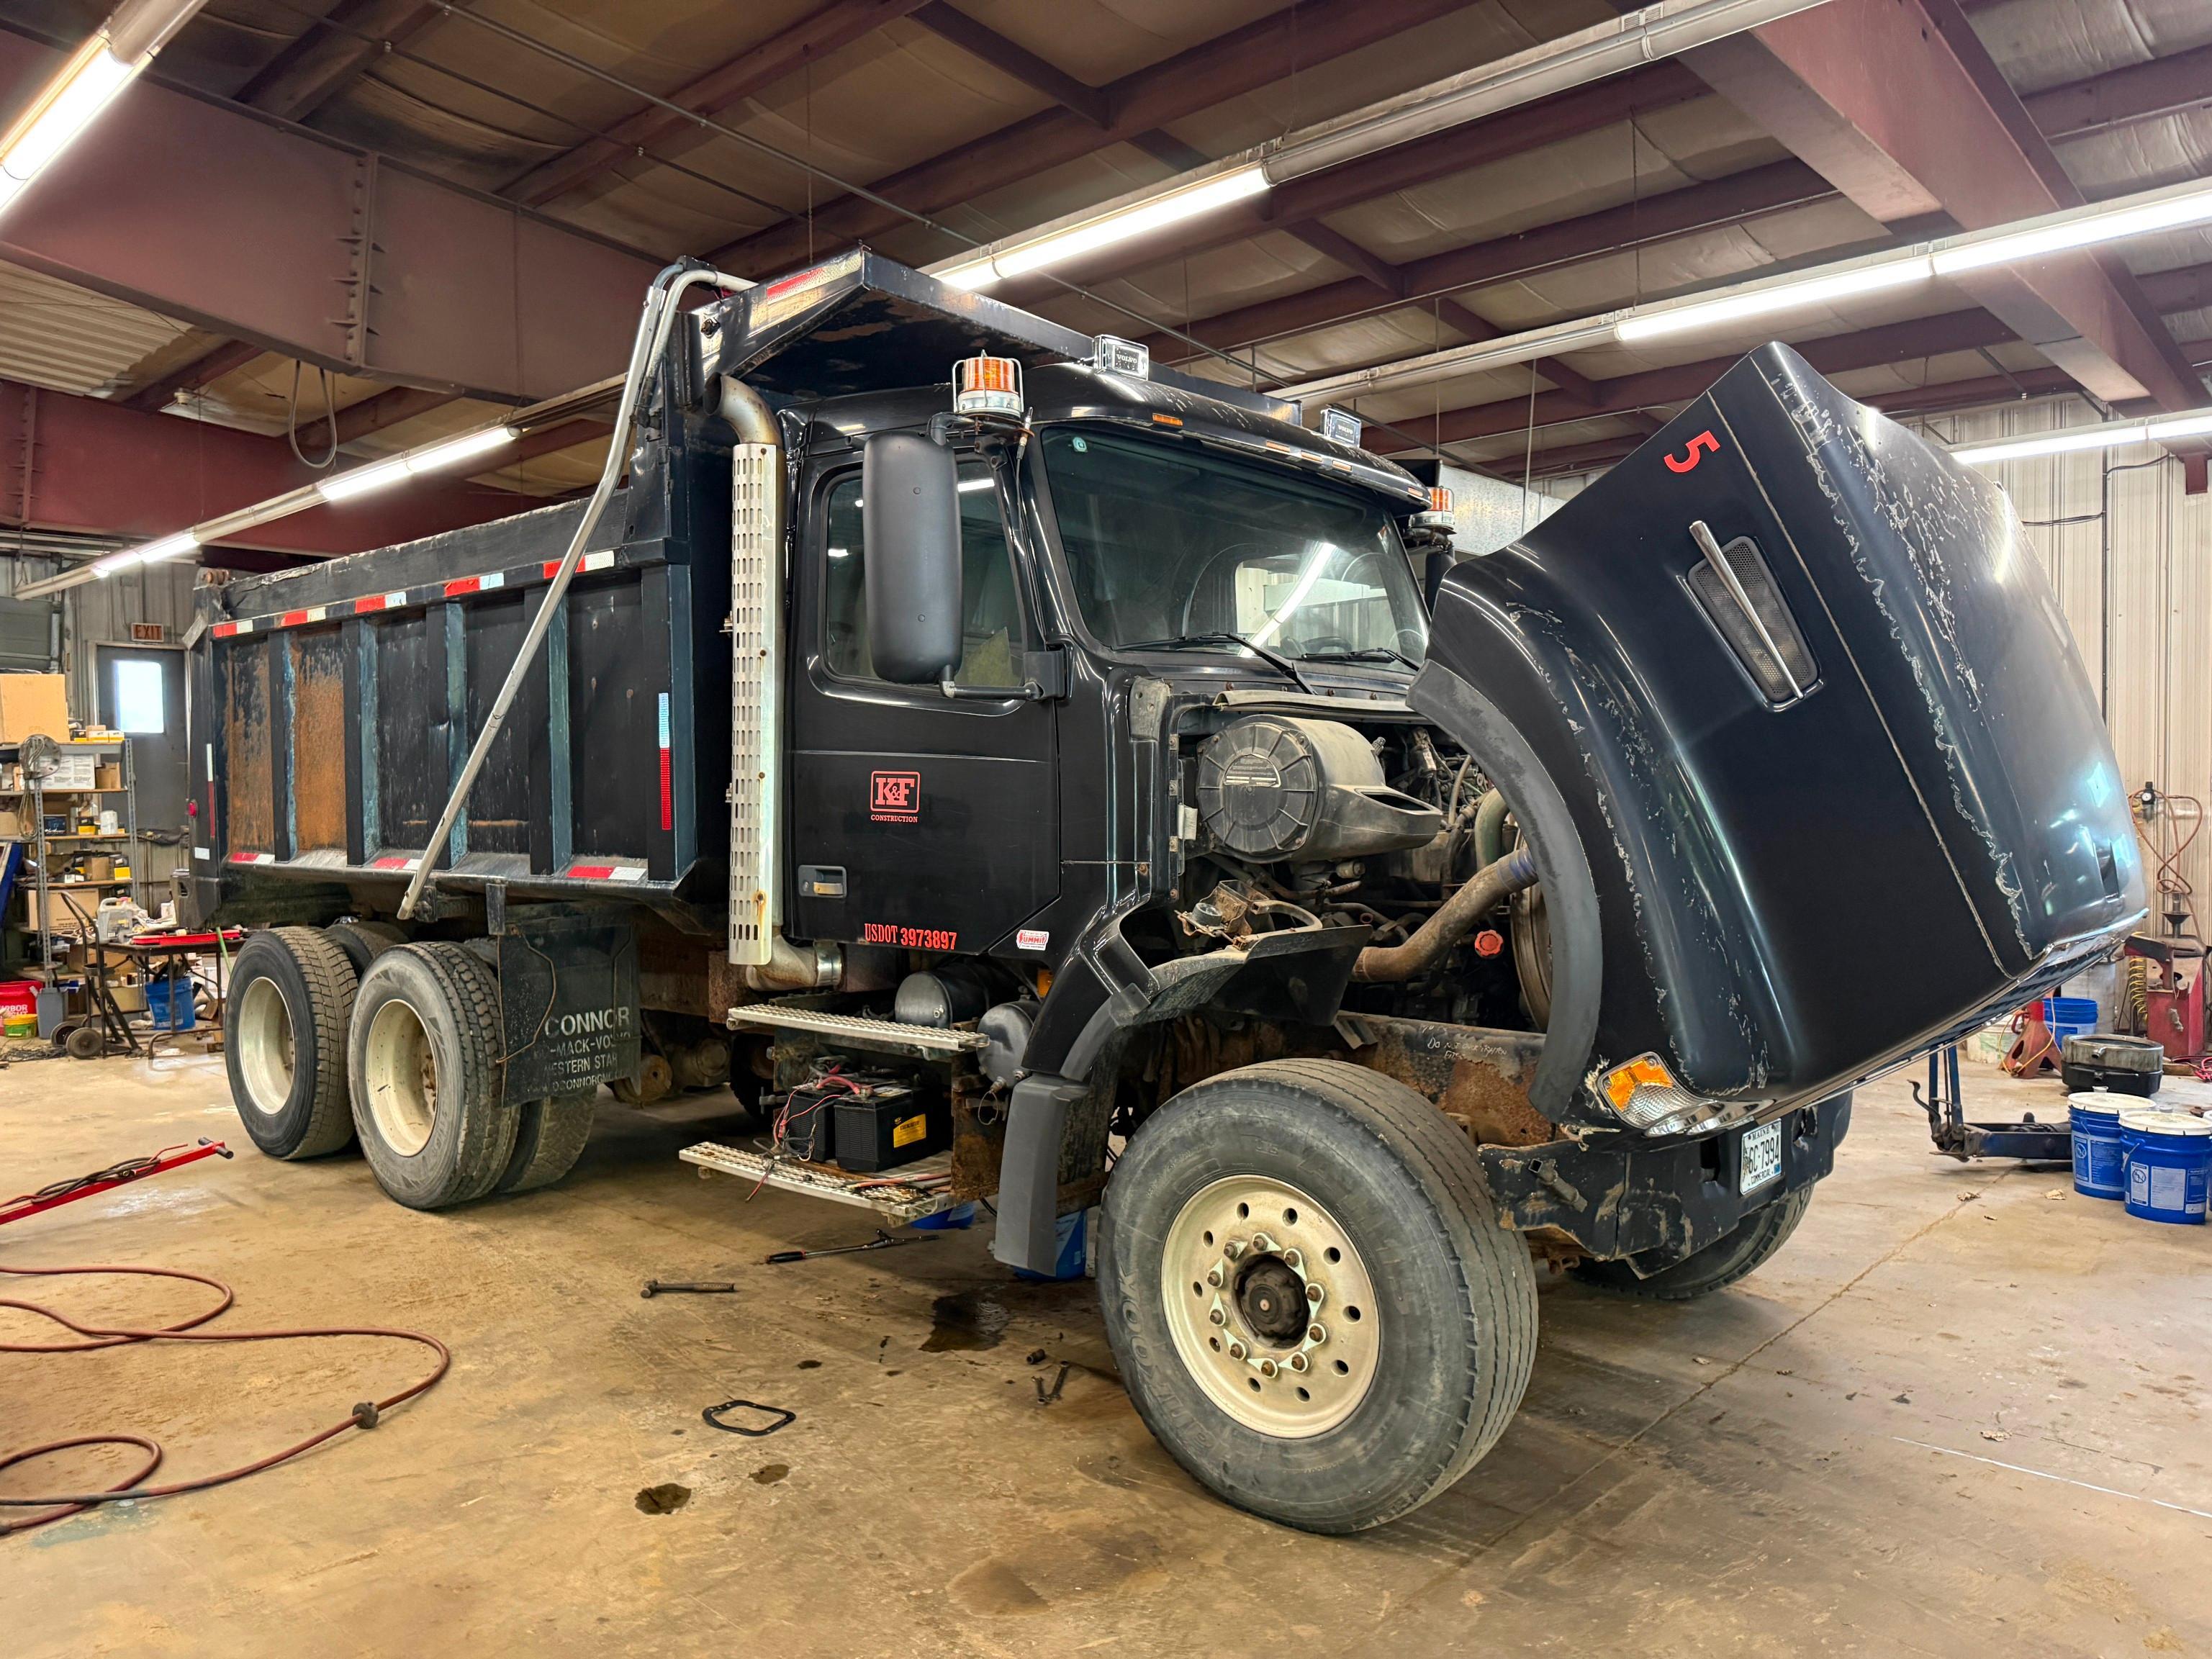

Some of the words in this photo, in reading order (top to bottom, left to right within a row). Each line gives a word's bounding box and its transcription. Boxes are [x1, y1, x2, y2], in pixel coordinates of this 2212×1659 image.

[1116, 353, 1138, 364] VOLVO
[1663, 430, 1720, 473] 5
[135, 625, 162, 640] EXIT
[875, 777, 915, 806] K&F
[870, 814, 918, 823] CONSTRUCTION
[865, 923, 898, 944] USDOT
[900, 927, 957, 950] 3973897
[1752, 1127, 1770, 1141] MAINE
